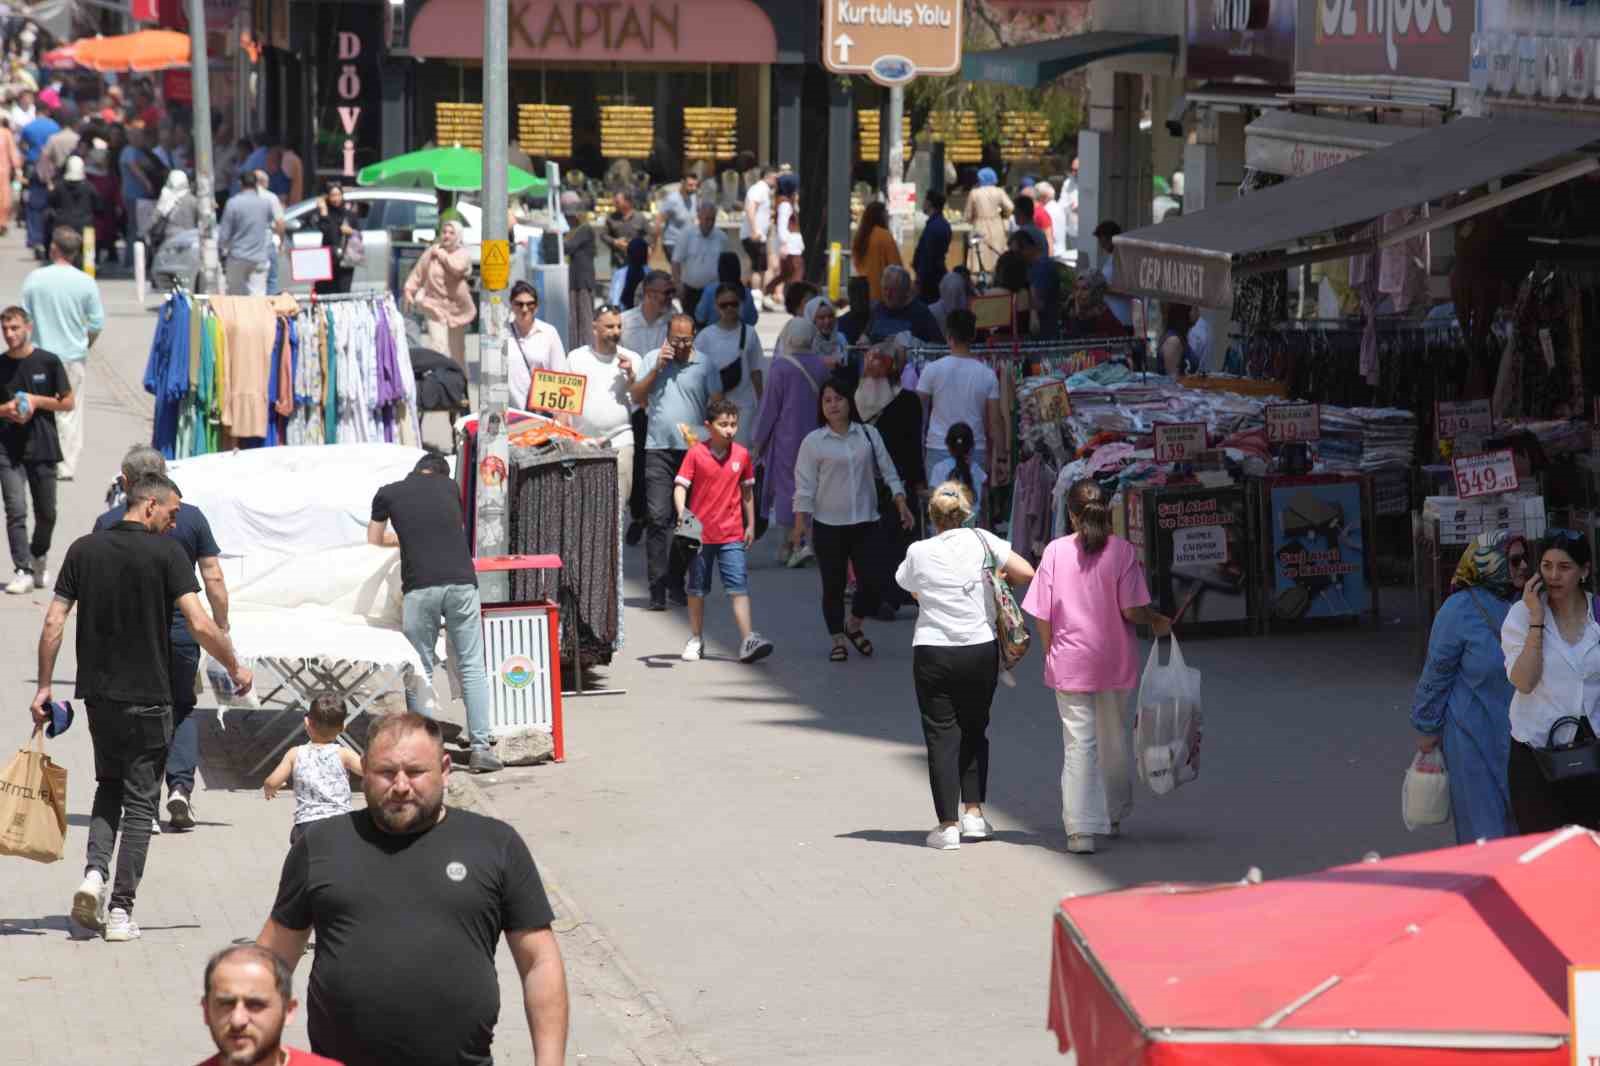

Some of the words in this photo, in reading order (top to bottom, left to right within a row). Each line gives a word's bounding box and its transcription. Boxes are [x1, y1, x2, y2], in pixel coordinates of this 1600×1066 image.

[508, 0, 679, 50] KAPTAN
[838, 0, 912, 27] Kurtuluş
[915, 4, 951, 25] Yolu
[1138, 256, 1161, 290] CEP
[1162, 258, 1204, 299] MARKET
[1456, 467, 1497, 495] 349
